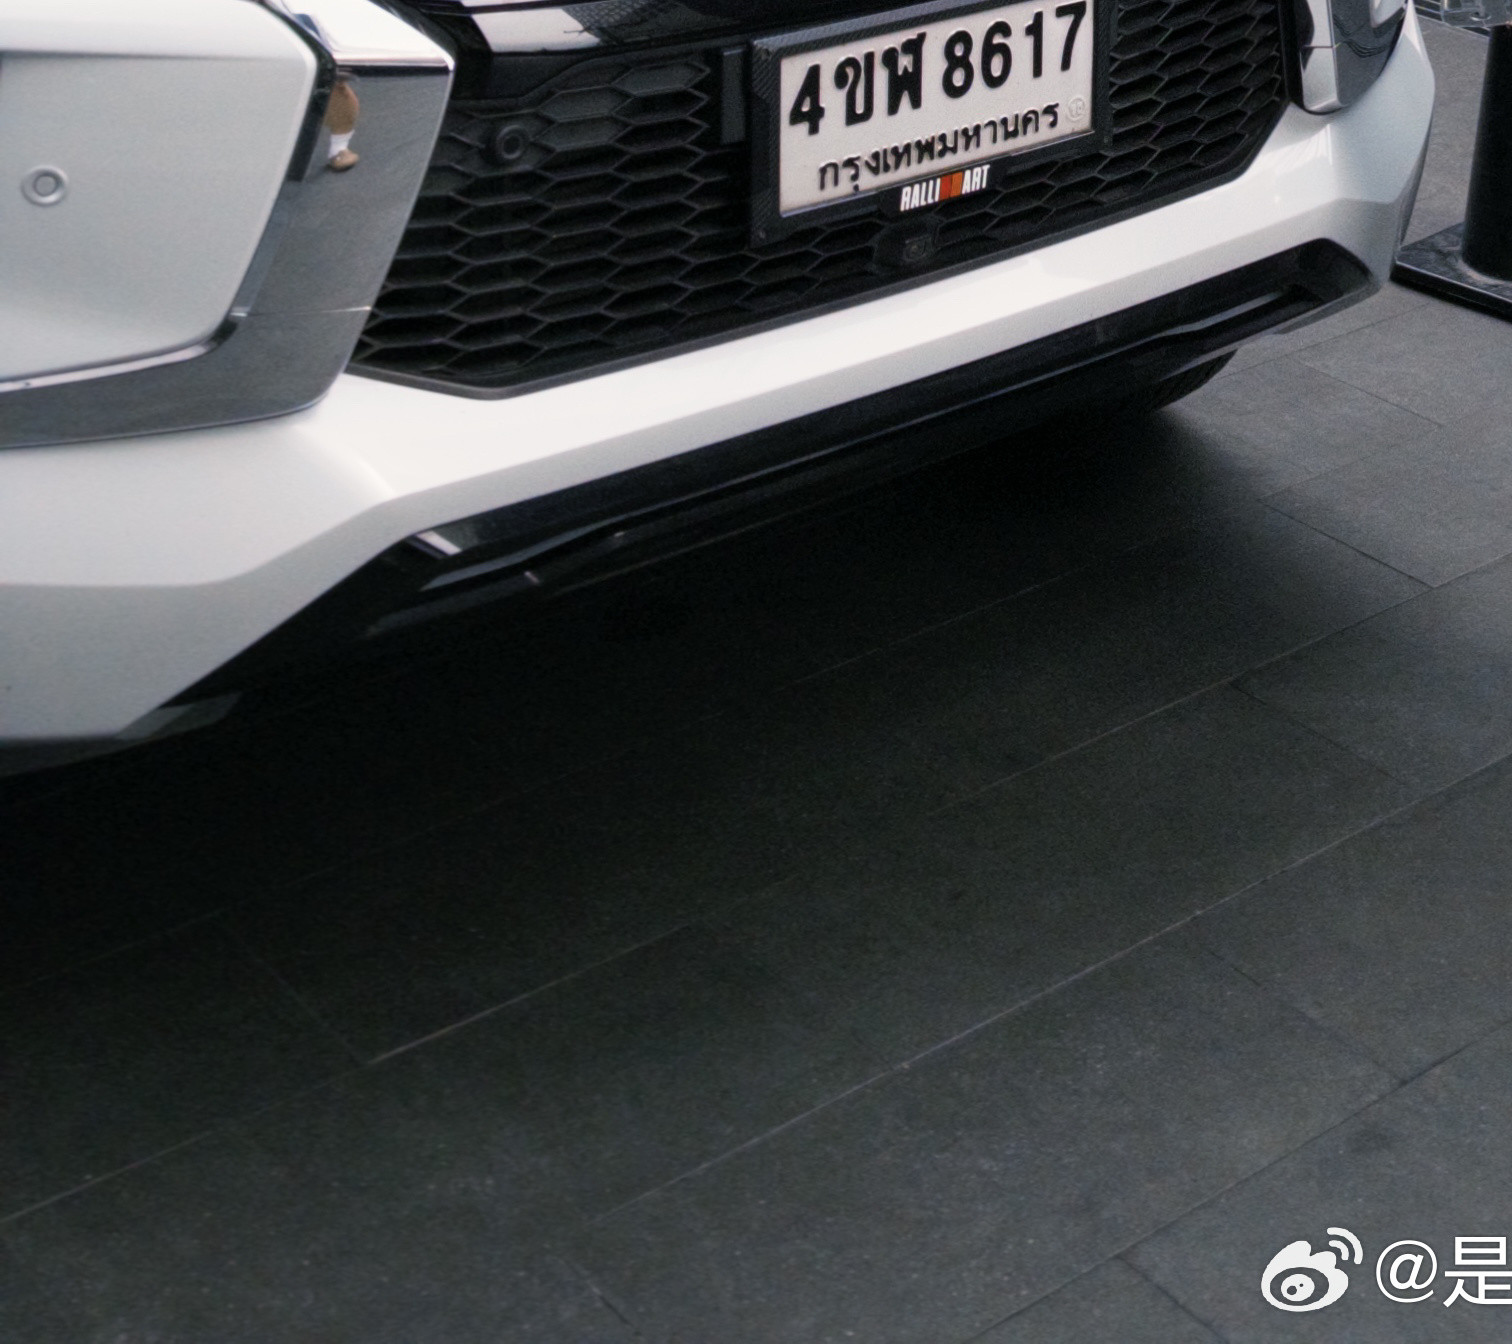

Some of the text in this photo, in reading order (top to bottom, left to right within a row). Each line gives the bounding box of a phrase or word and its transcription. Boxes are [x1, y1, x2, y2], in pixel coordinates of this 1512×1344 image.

[789, 0, 1087, 136] 4ขฬ 8617
[818, 102, 1060, 193] กรุงเทพมหานคร
